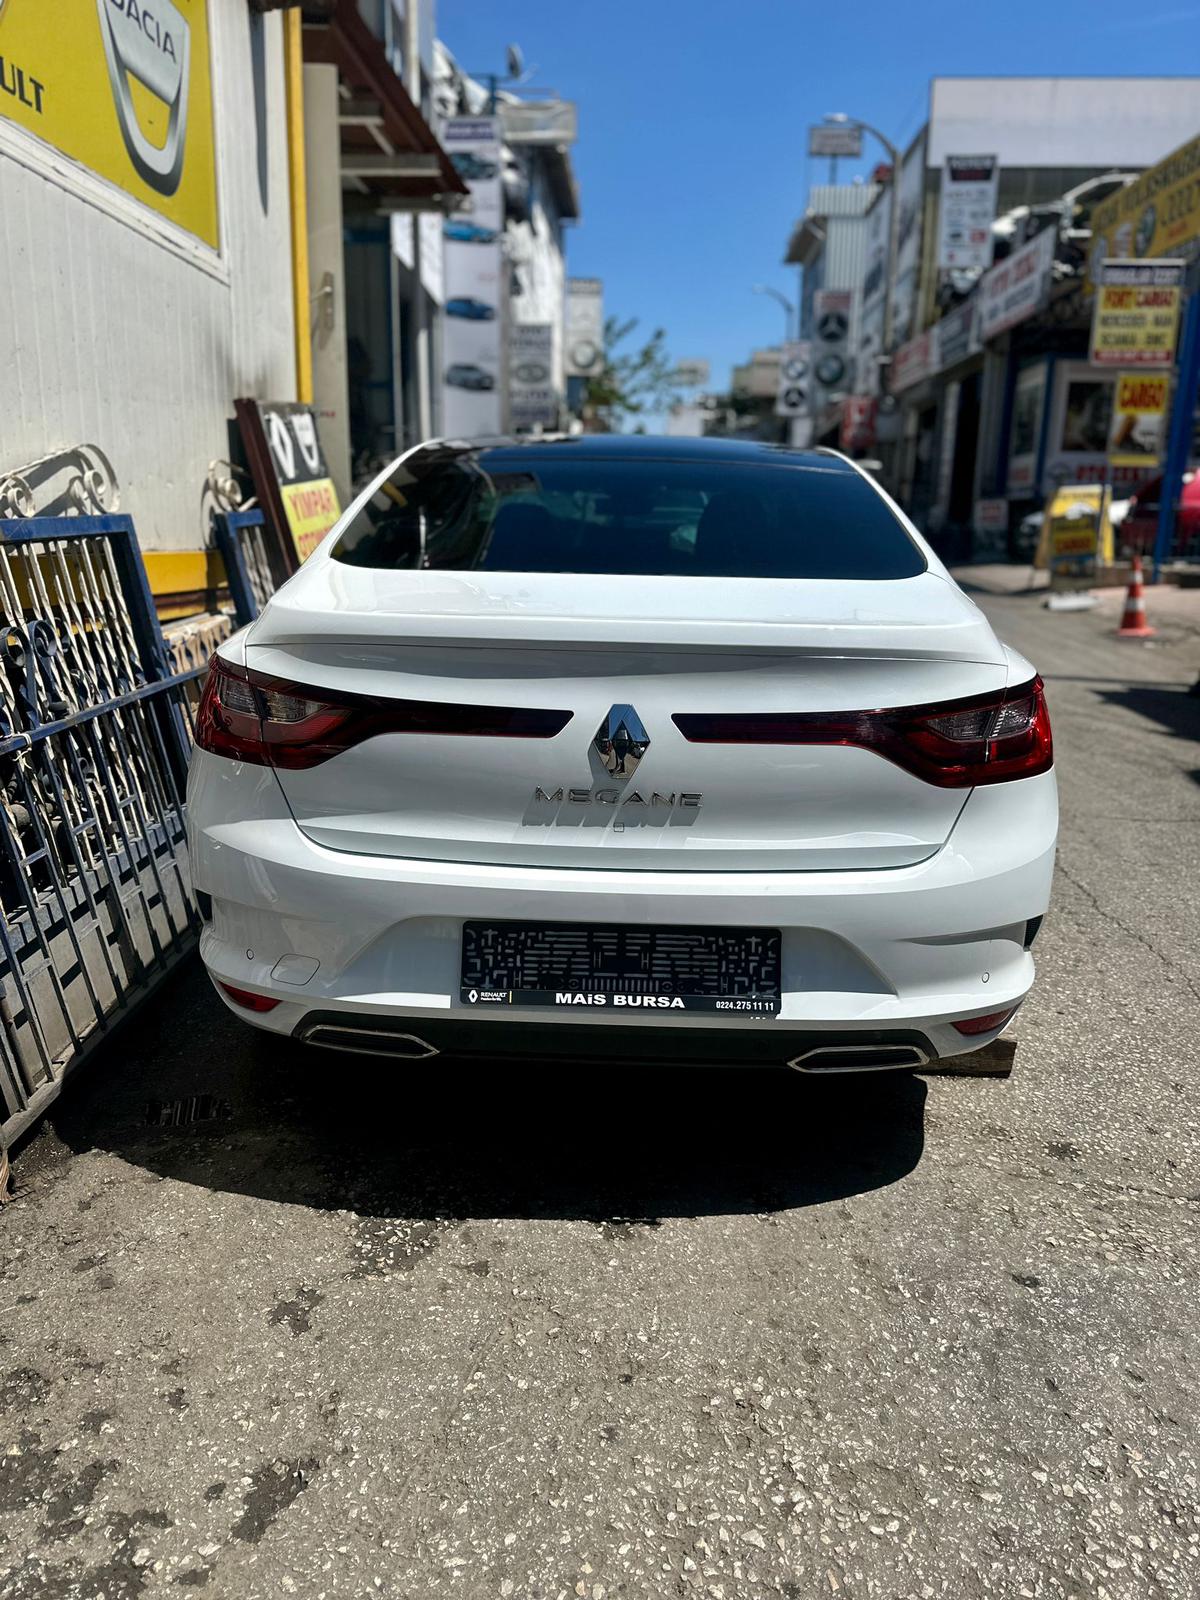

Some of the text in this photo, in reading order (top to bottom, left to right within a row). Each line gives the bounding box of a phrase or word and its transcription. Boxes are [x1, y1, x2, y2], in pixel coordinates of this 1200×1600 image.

[1120, 382, 1163, 409] CARGO
[535, 784, 704, 808] MEGANE
[613, 994, 686, 1009] BURSA
